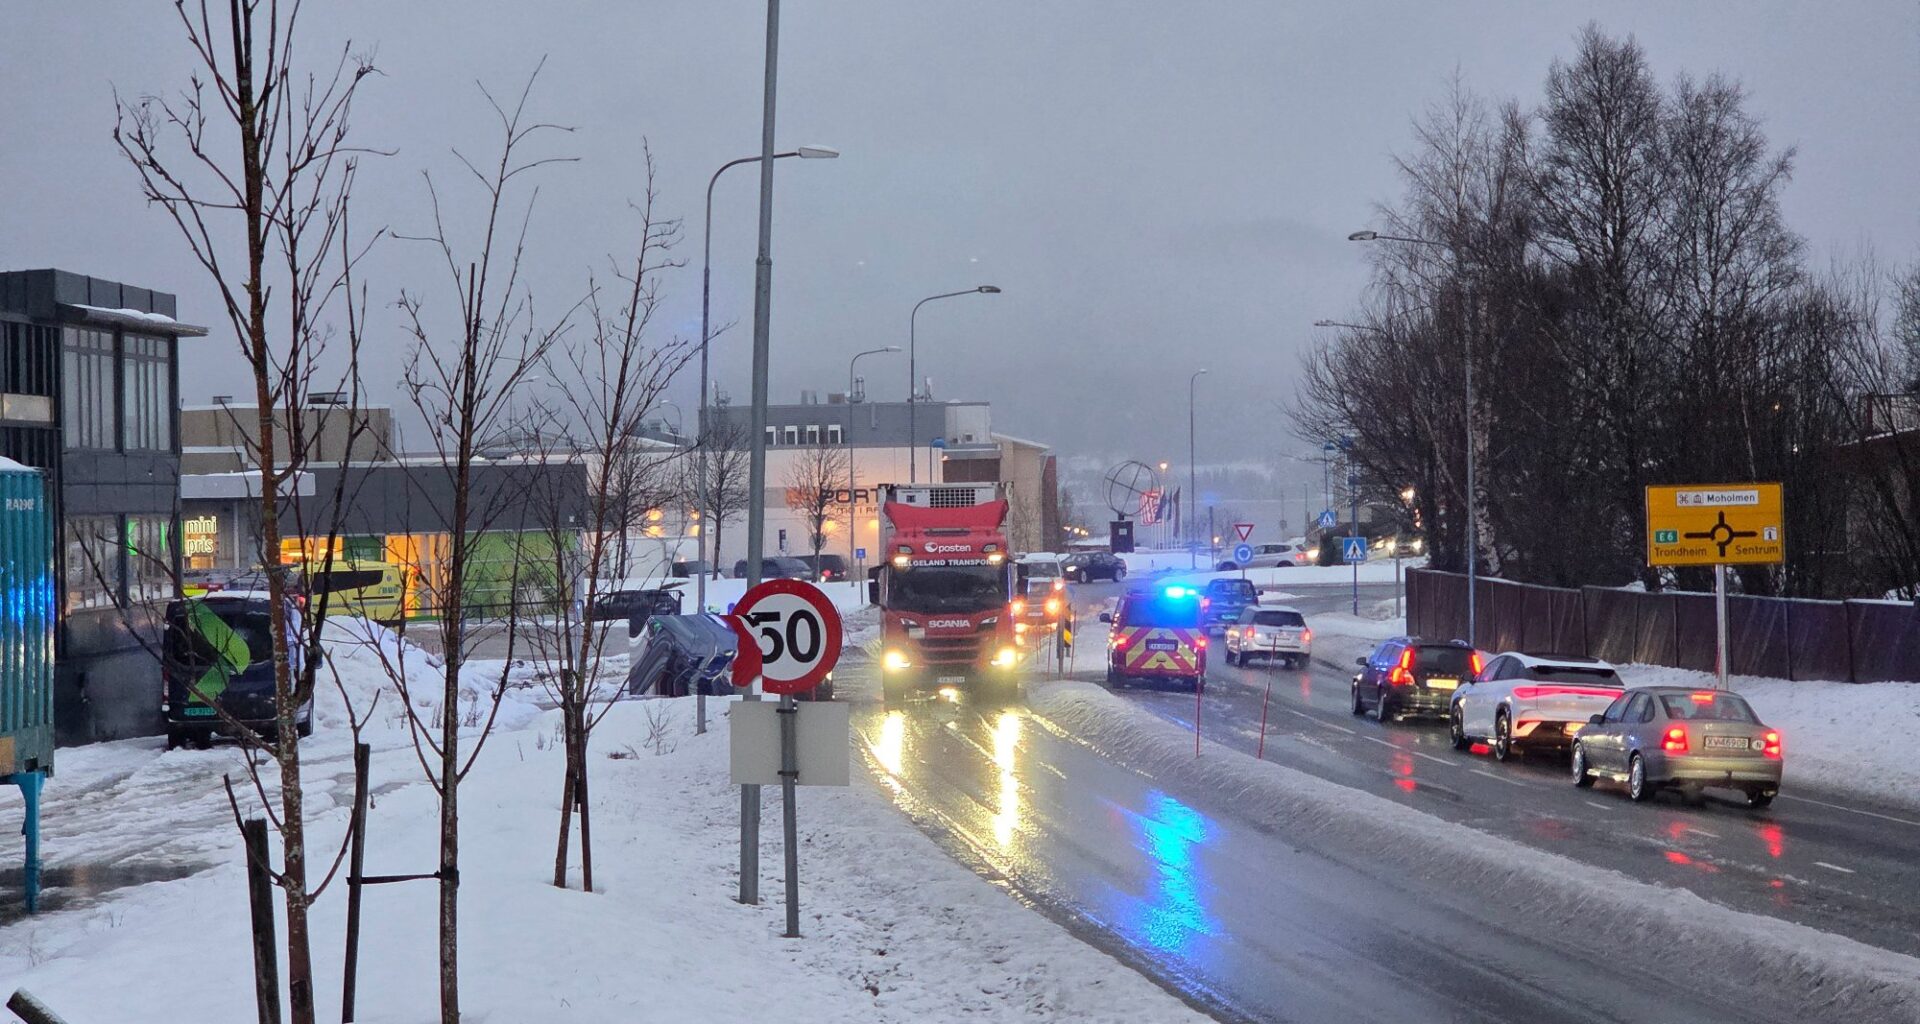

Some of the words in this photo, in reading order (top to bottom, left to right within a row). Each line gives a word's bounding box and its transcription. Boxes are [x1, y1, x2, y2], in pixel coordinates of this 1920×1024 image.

[1707, 493, 1756, 503] Moholmen
[186, 515, 217, 535] mini
[186, 535, 214, 557] pris
[938, 544, 972, 554] posten
[1735, 545, 1779, 556] Sentrum
[1655, 546, 1707, 558] Trondheim
[928, 619, 971, 628] SCANIA
[751, 608, 821, 664] 50
